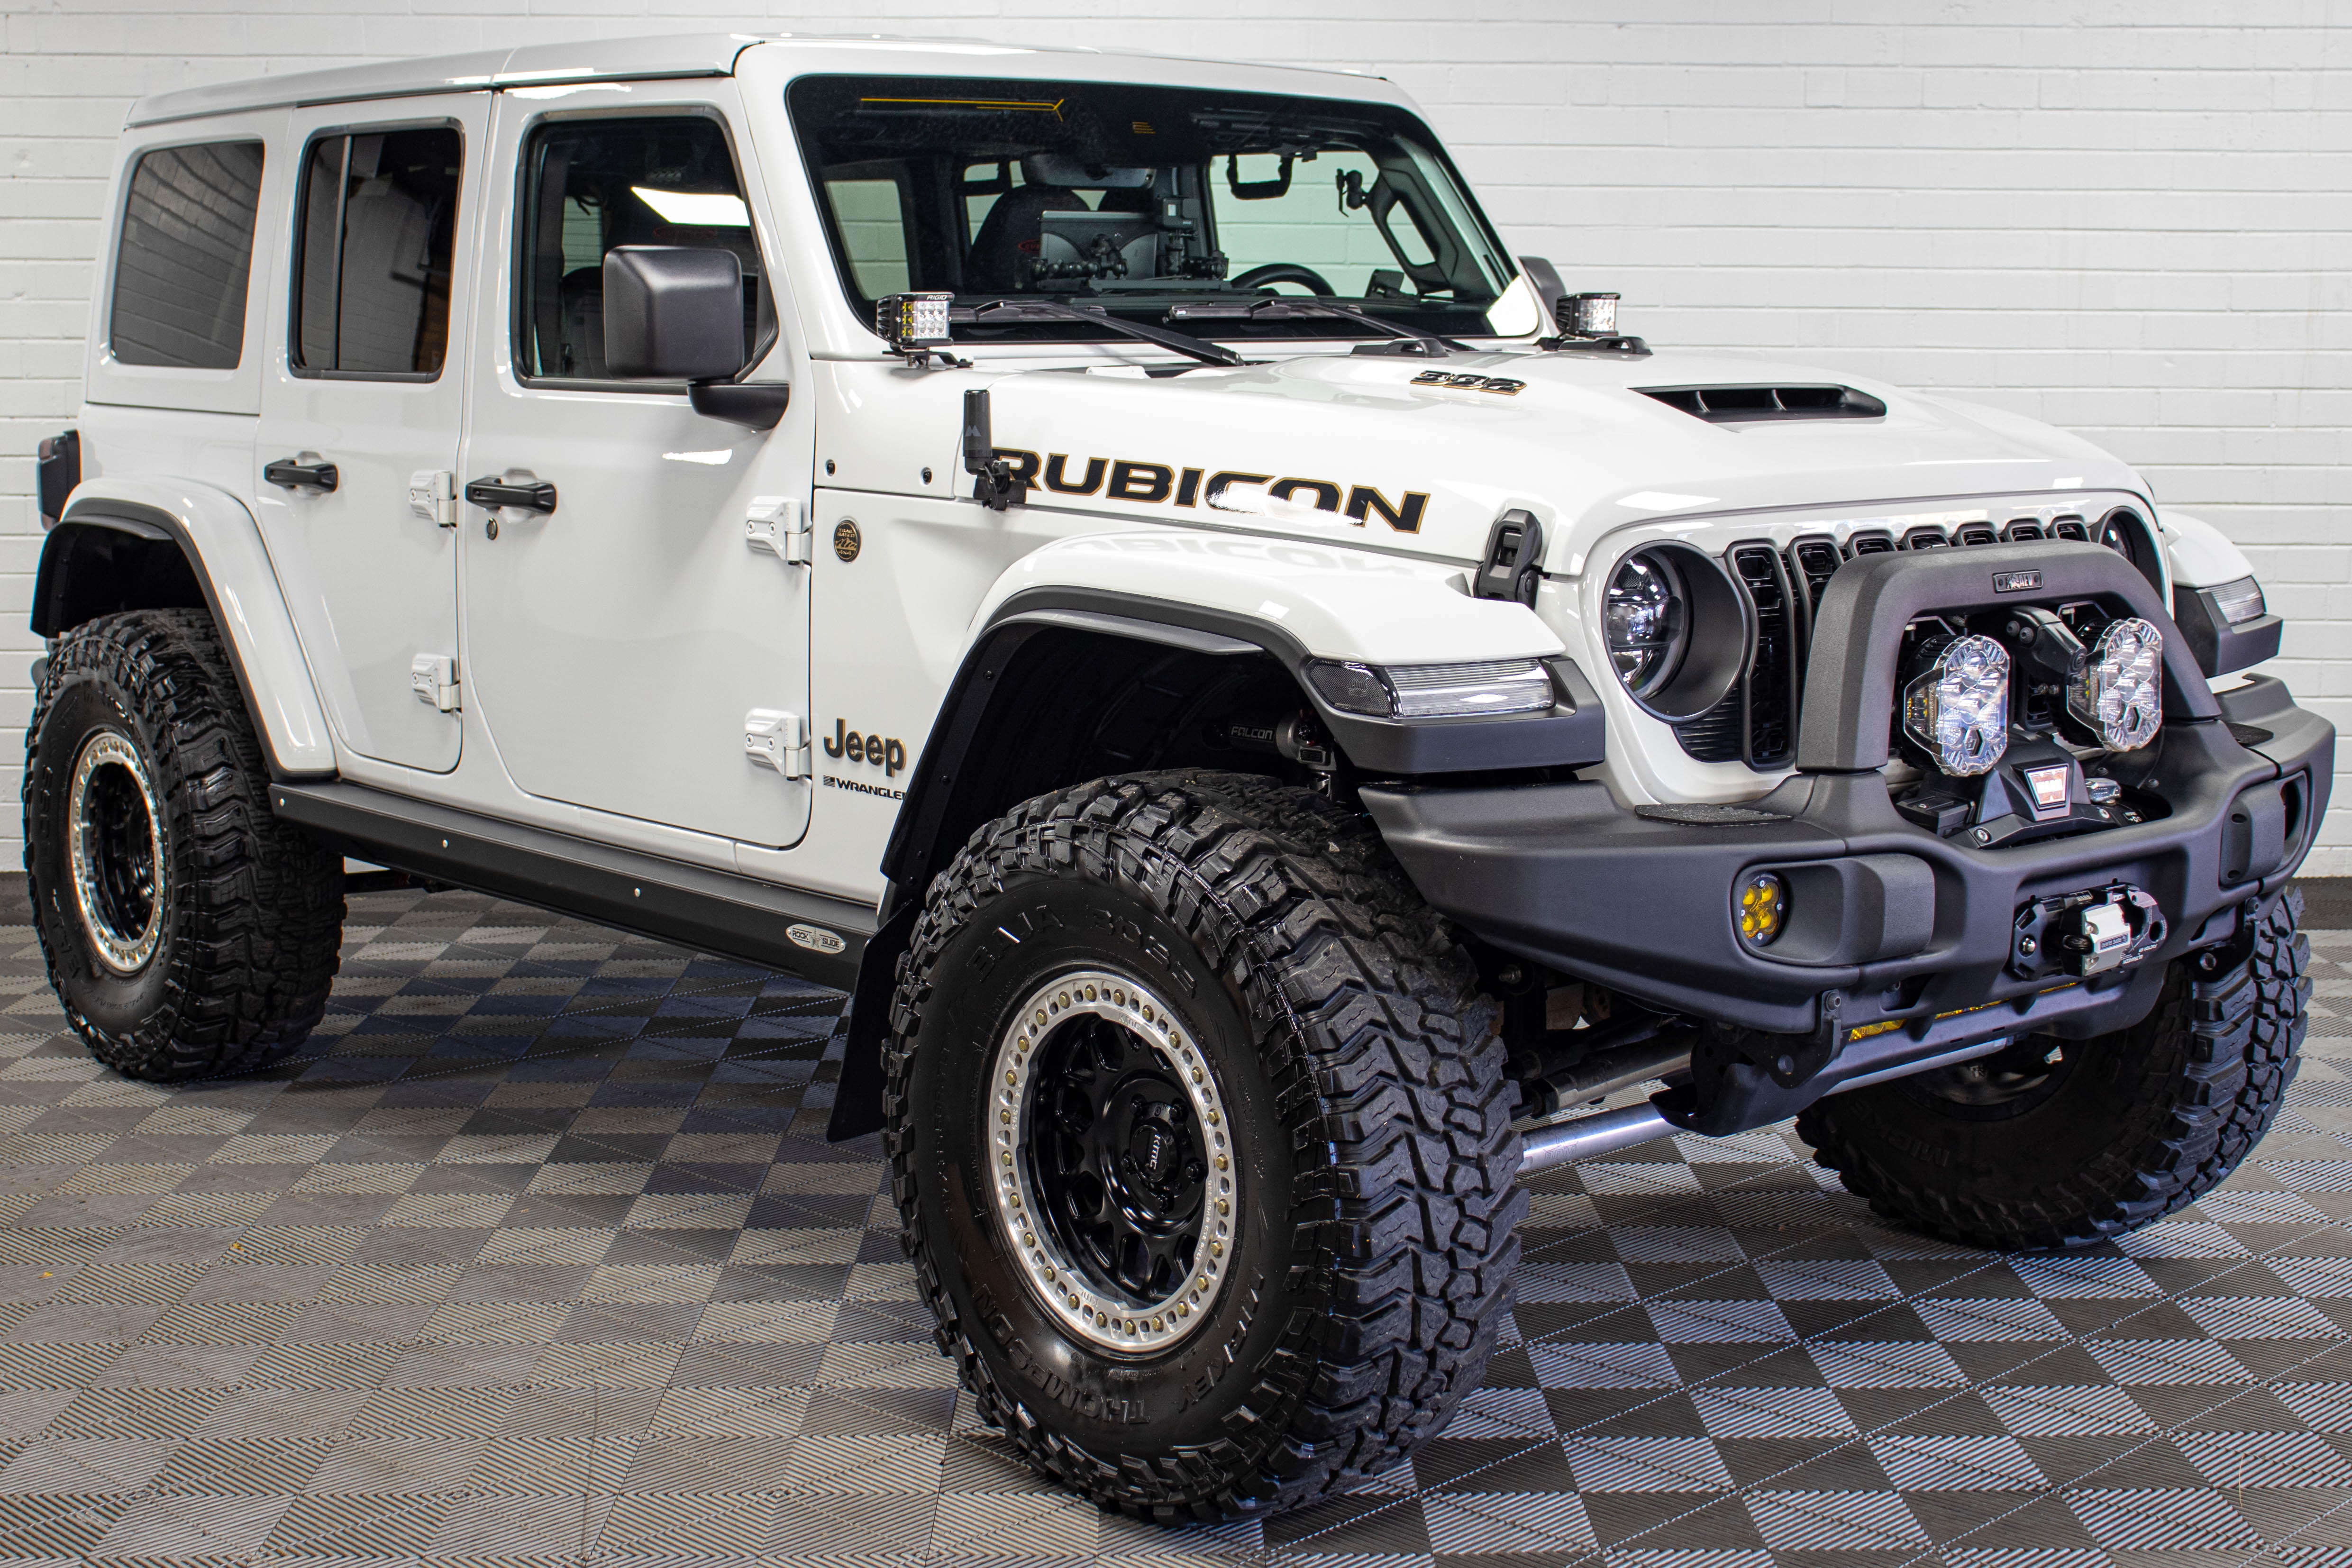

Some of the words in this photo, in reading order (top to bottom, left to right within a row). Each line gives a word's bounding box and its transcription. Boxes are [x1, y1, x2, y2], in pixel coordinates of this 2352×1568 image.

[991, 446, 1431, 534] RUBICON
[823, 718, 907, 778] Jeep
[1231, 726, 1273, 740] FALCON
[792, 930, 809, 940] ROCK
[822, 938, 840, 948] SLIDE
[966, 904, 1065, 983] BAJA
[1086, 904, 1197, 998] BOSS
[1850, 1097, 1951, 1167] MICKE
[972, 1283, 1150, 1424] THOMPSON
